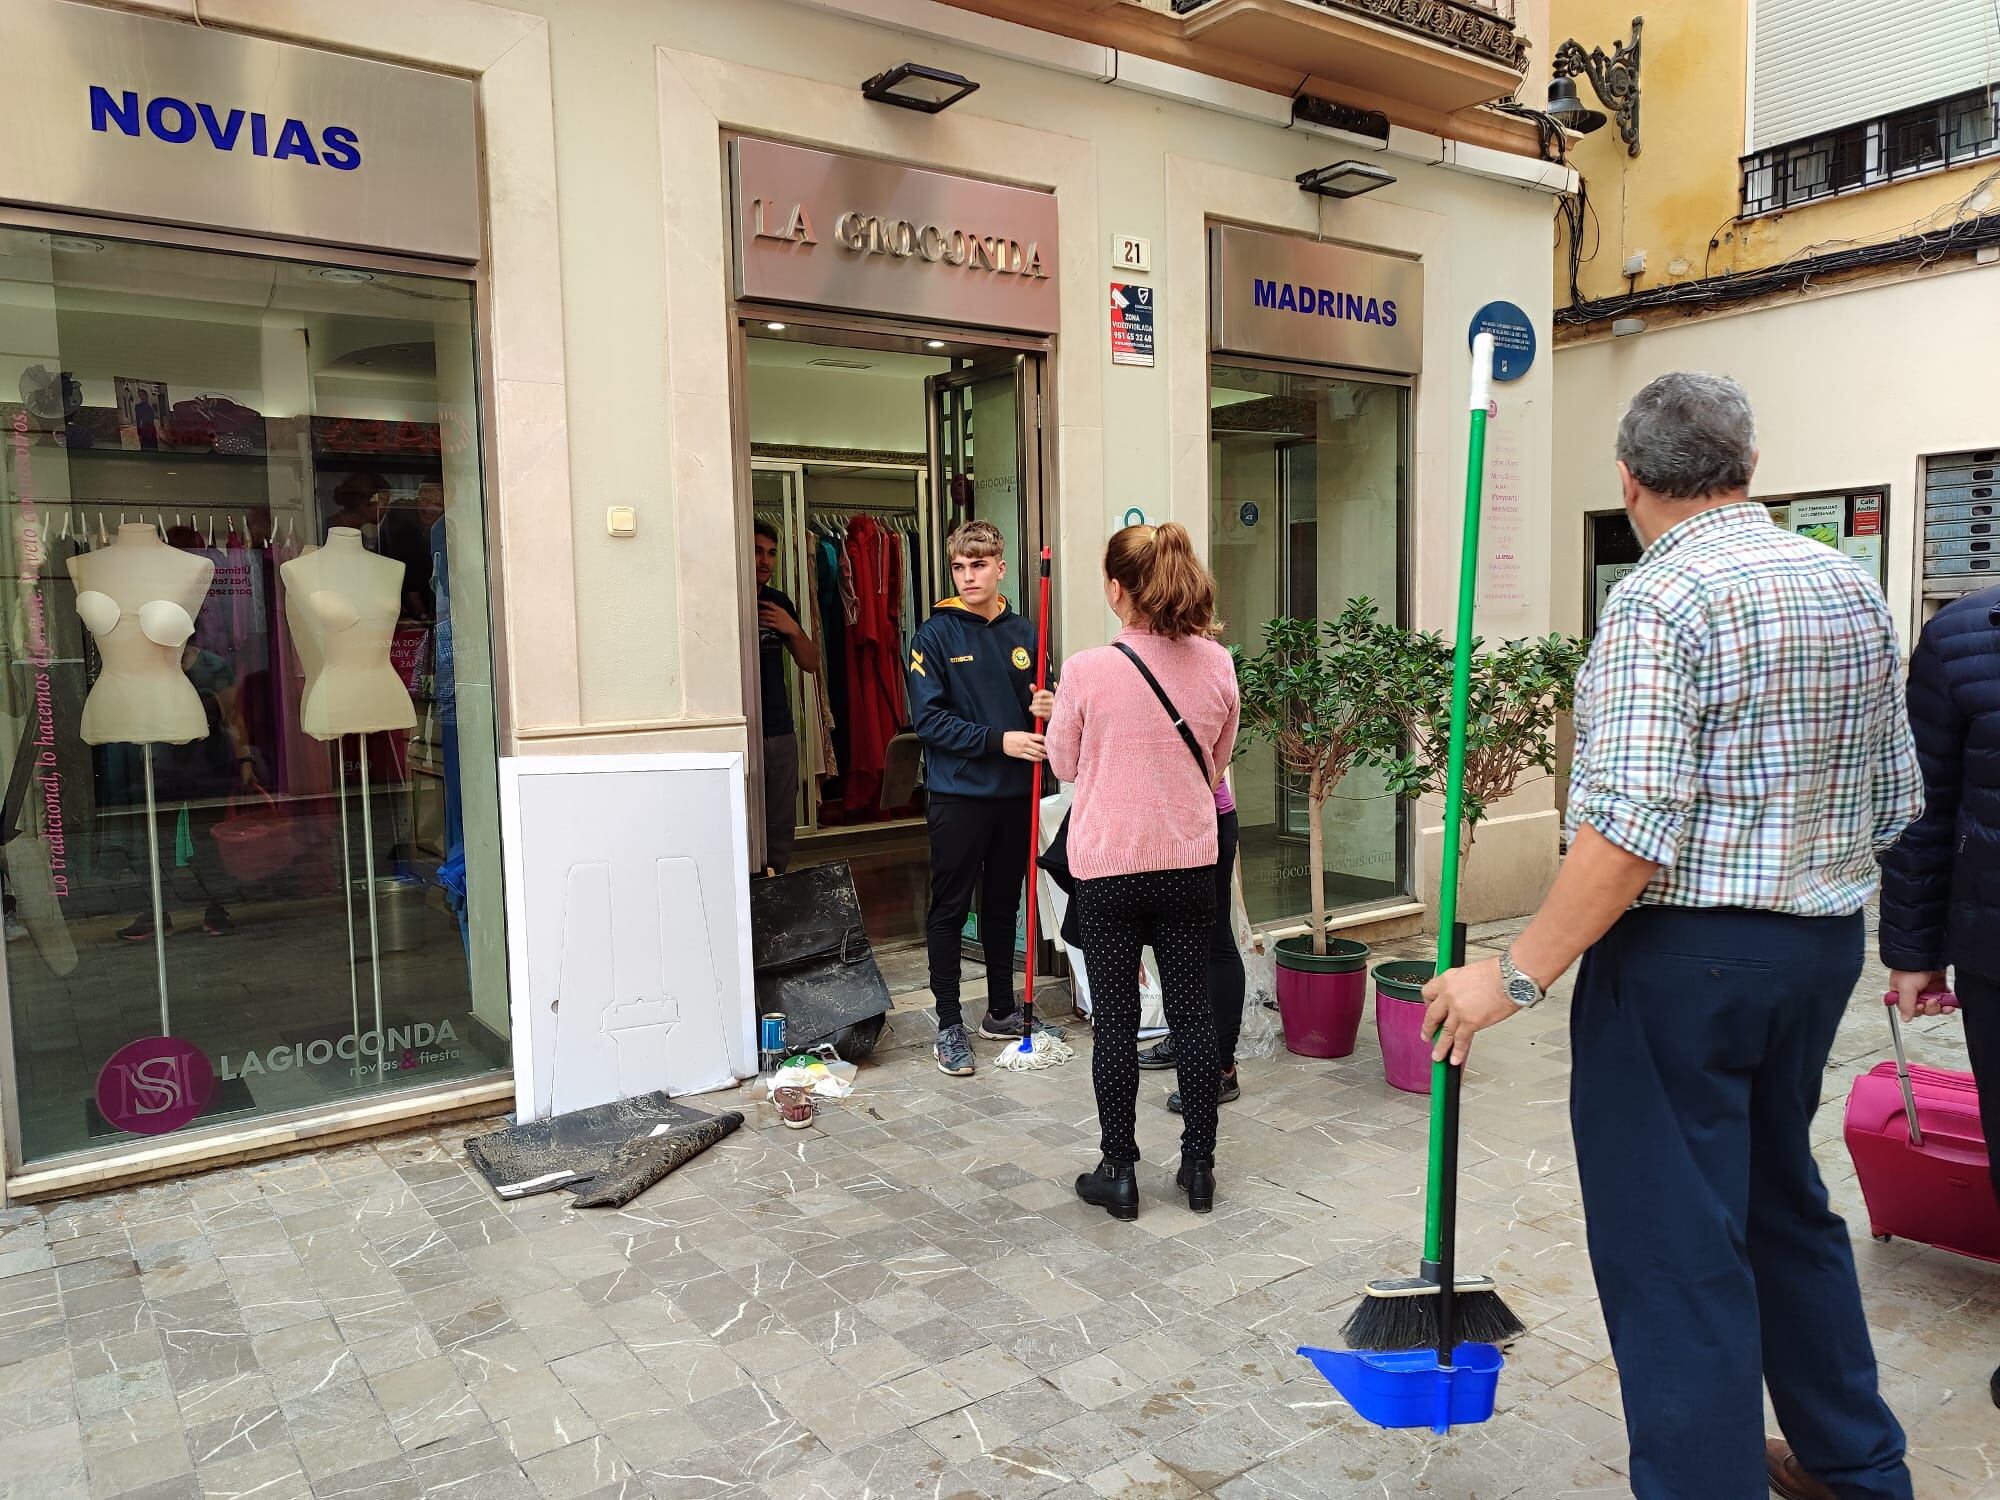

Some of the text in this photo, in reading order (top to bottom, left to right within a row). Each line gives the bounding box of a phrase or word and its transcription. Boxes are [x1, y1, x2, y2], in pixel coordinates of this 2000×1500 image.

[90, 85, 361, 170] NOVIAS
[752, 197, 1051, 279] LA GIOCONDA
[1124, 241, 1141, 264] 21
[1125, 314, 1140, 322] ZONA
[1254, 278, 1397, 327] MADRINAS
[1112, 321, 1153, 333] VIDEOVIGILADA
[33, 674, 56, 746] hacemos
[35, 751, 57, 767] lo
[36, 772, 65, 869] tradicional,
[48, 874, 69, 897] Lo
[220, 1019, 458, 1081] LAGIOCONDA
[401, 1050, 418, 1070] &
[419, 1049, 460, 1065] fiesta
